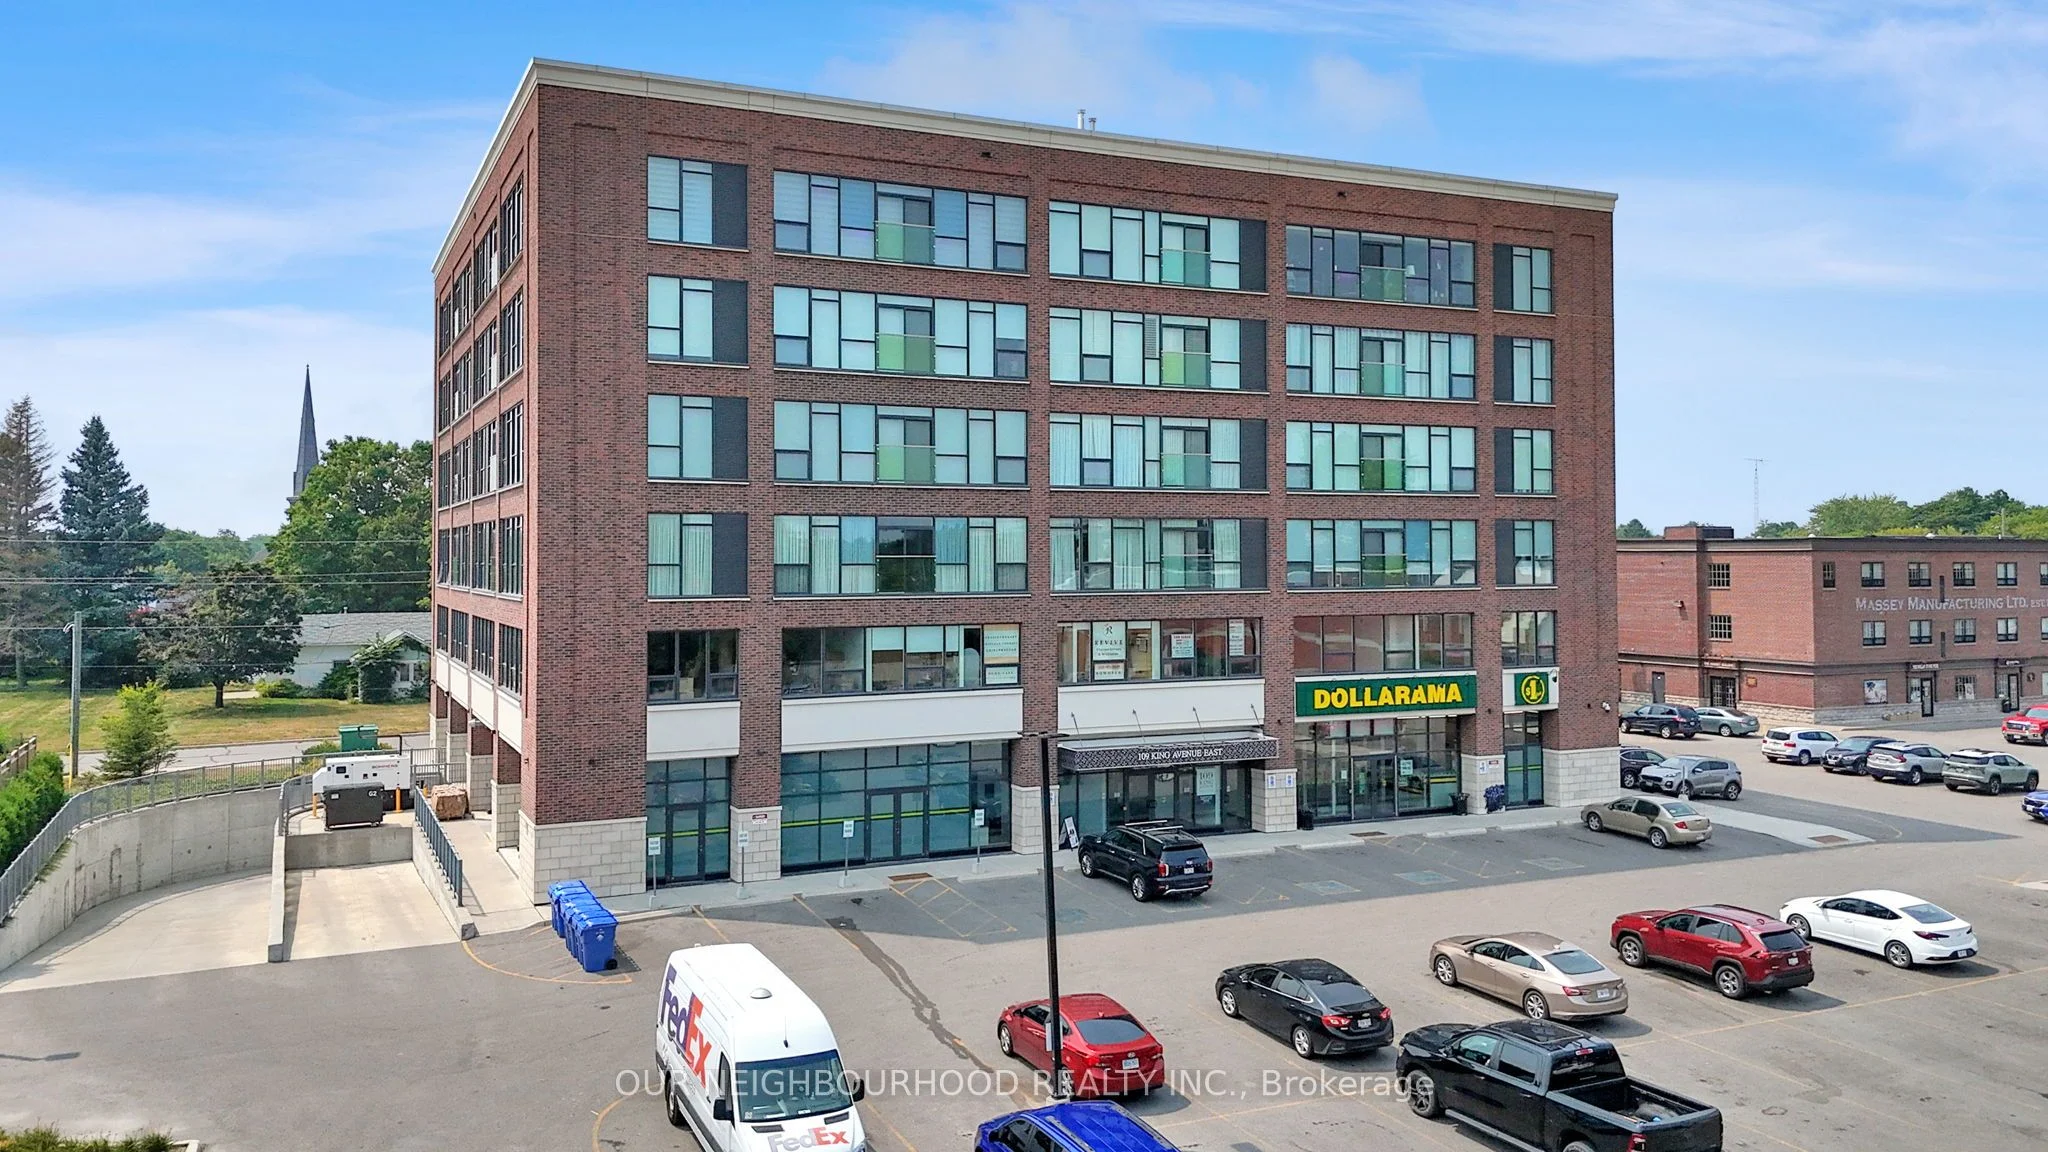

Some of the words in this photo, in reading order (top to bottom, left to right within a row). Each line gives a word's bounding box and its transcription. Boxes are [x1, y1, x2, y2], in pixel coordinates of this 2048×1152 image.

[1908, 597, 2004, 610] MANUFACTURING
[2006, 595, 2029, 609] LTD.
[1313, 683, 1463, 710] DOLLARAMA
[1138, 752, 1150, 761] 109
[1172, 749, 1202, 759] AVENUE
[1203, 748, 1223, 757] EAST
[660, 963, 712, 1089] FedEx
[767, 1127, 850, 1152] FedEx
